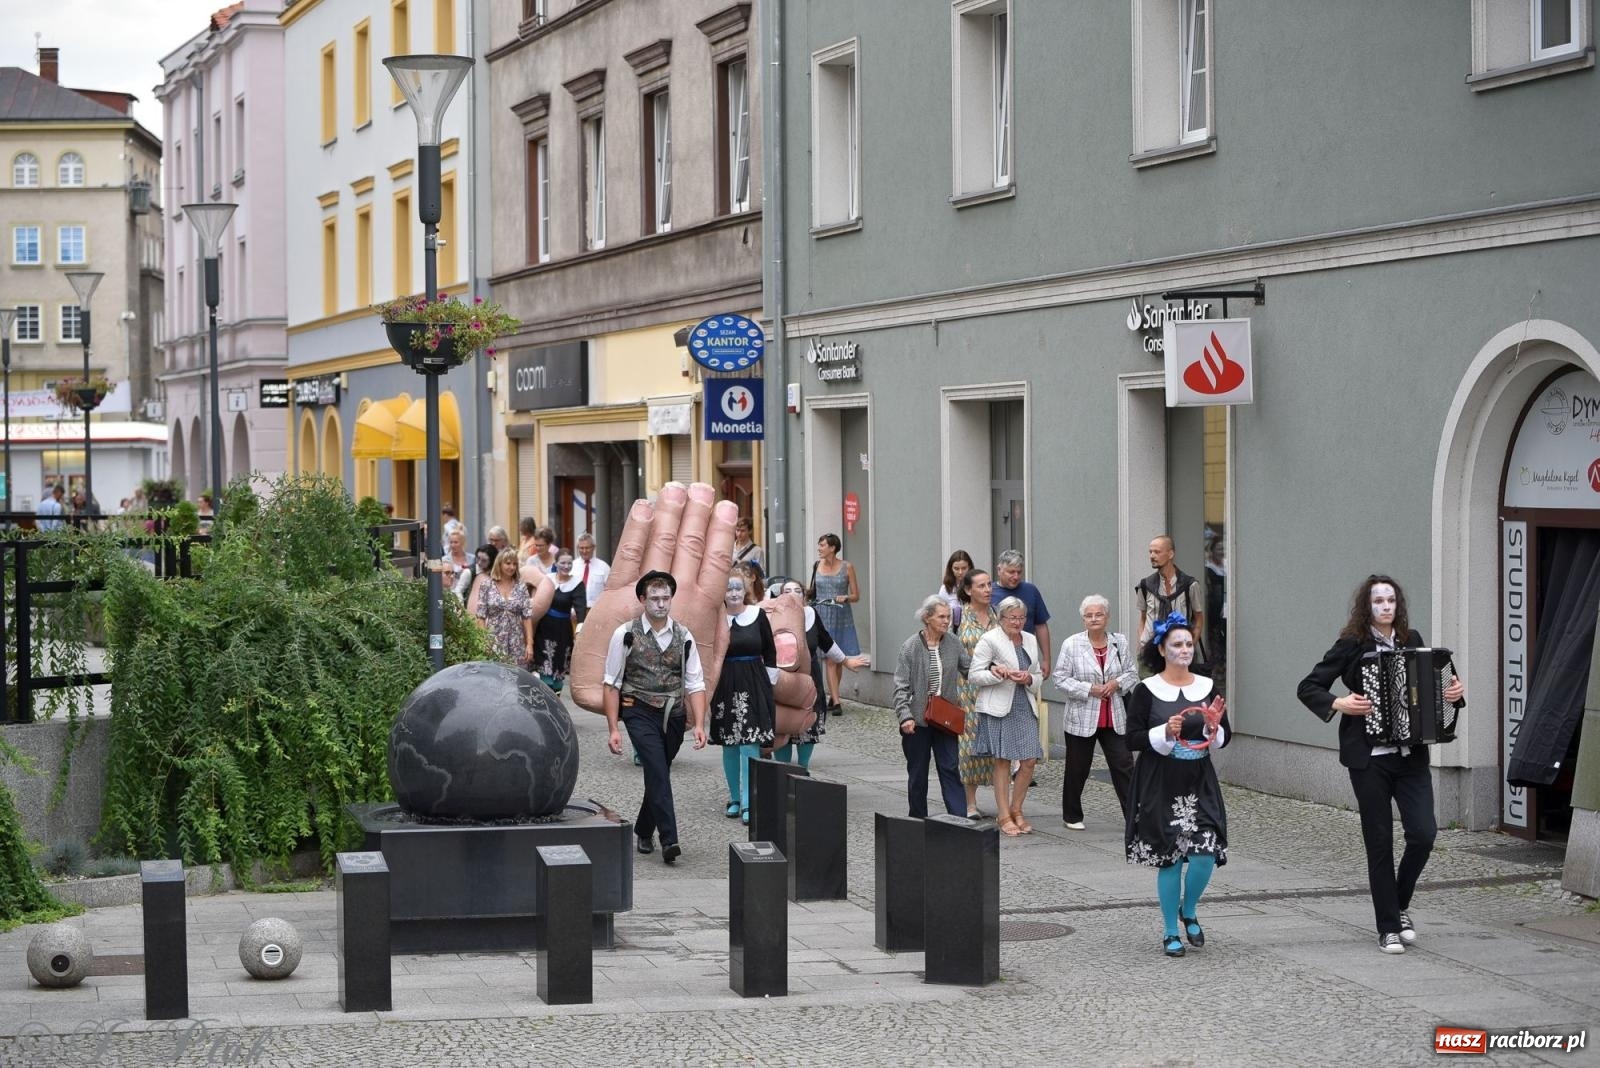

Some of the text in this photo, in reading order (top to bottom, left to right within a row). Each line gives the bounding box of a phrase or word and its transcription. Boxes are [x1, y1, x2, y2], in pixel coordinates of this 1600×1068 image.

[707, 337, 749, 347] KANTOR
[816, 341, 857, 363] Santander
[817, 364, 857, 381] Consumer Bank
[711, 421, 763, 434] Monetia
[1508, 528, 1523, 643] STUDIO
